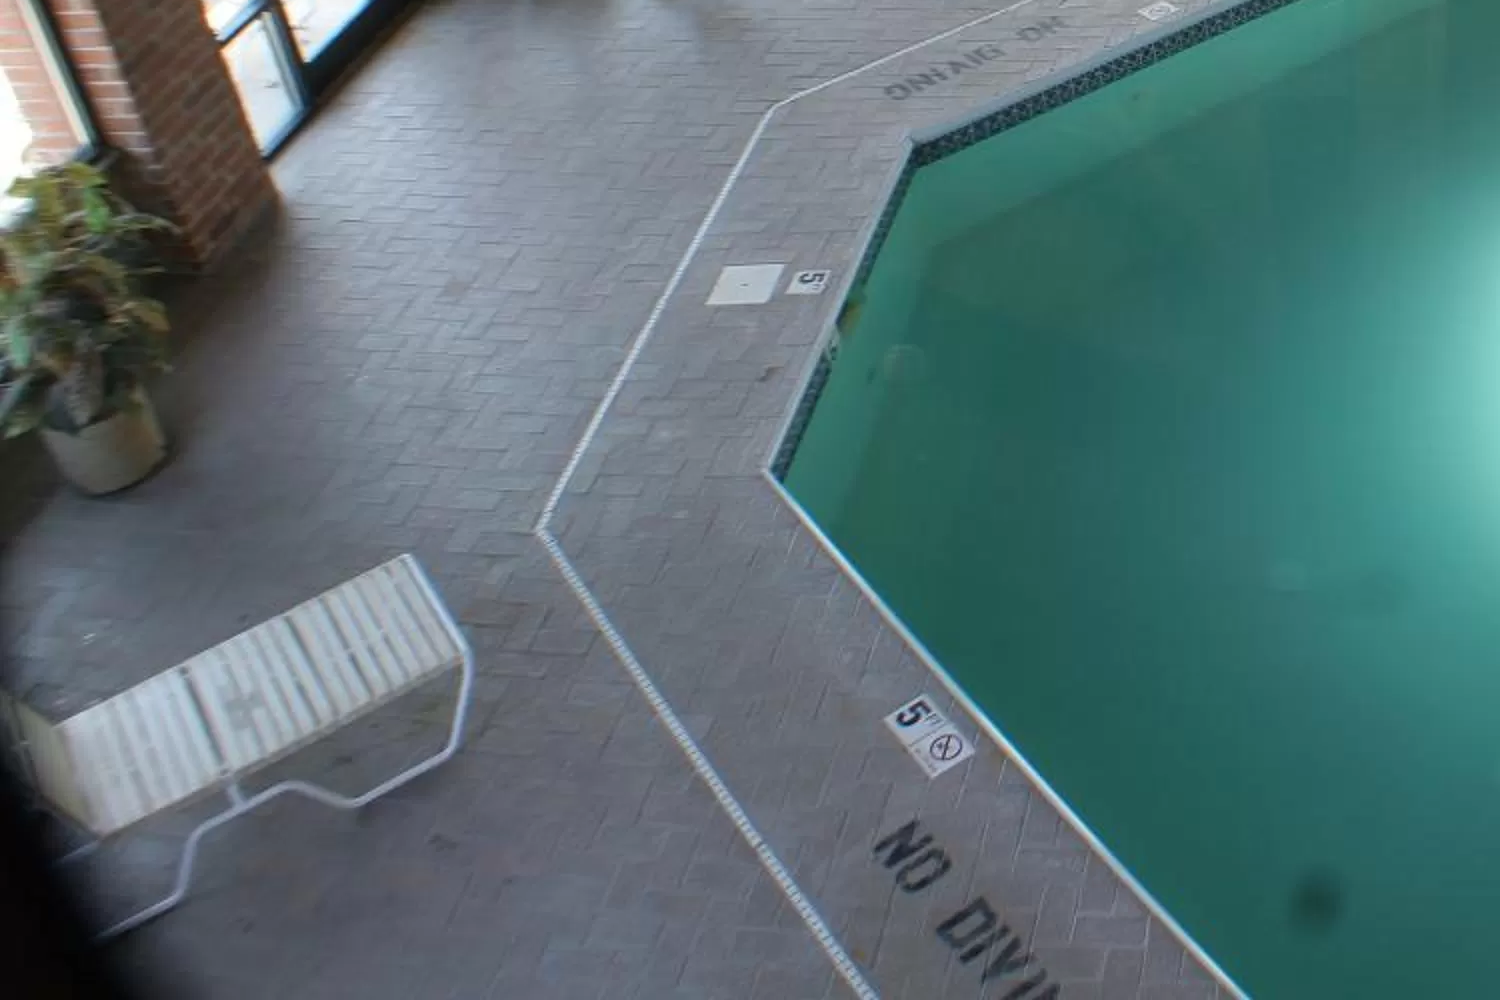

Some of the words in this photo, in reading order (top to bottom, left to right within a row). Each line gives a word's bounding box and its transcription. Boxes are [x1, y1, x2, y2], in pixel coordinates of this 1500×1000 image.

[896, 700, 932, 727] 5
[872, 819, 952, 894] NO
[936, 895, 1062, 1000] DIVI
